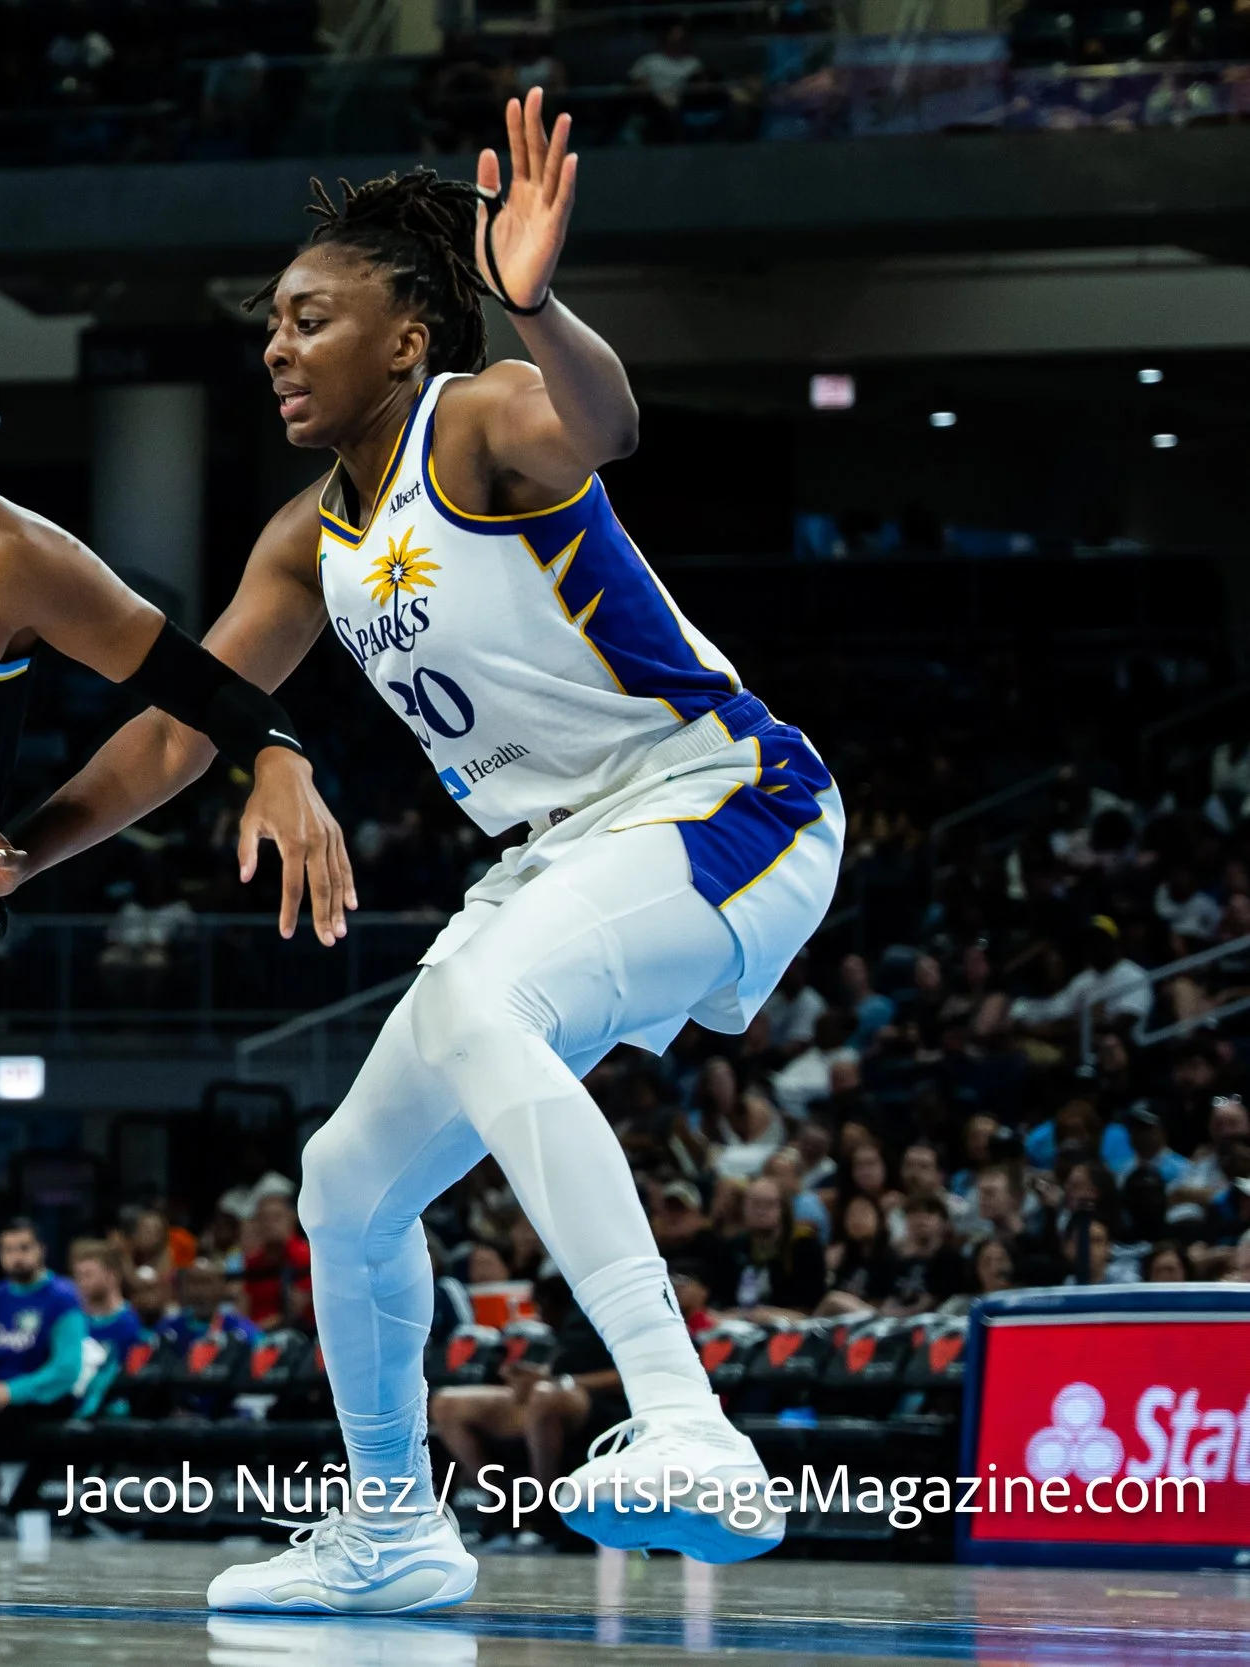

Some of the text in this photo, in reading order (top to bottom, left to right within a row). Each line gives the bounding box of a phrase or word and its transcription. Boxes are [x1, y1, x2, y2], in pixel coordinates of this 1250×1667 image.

[388, 480, 422, 515] Albert
[335, 596, 431, 671] SPARKS
[387, 666, 476, 750] 30
[460, 742, 531, 785] Health
